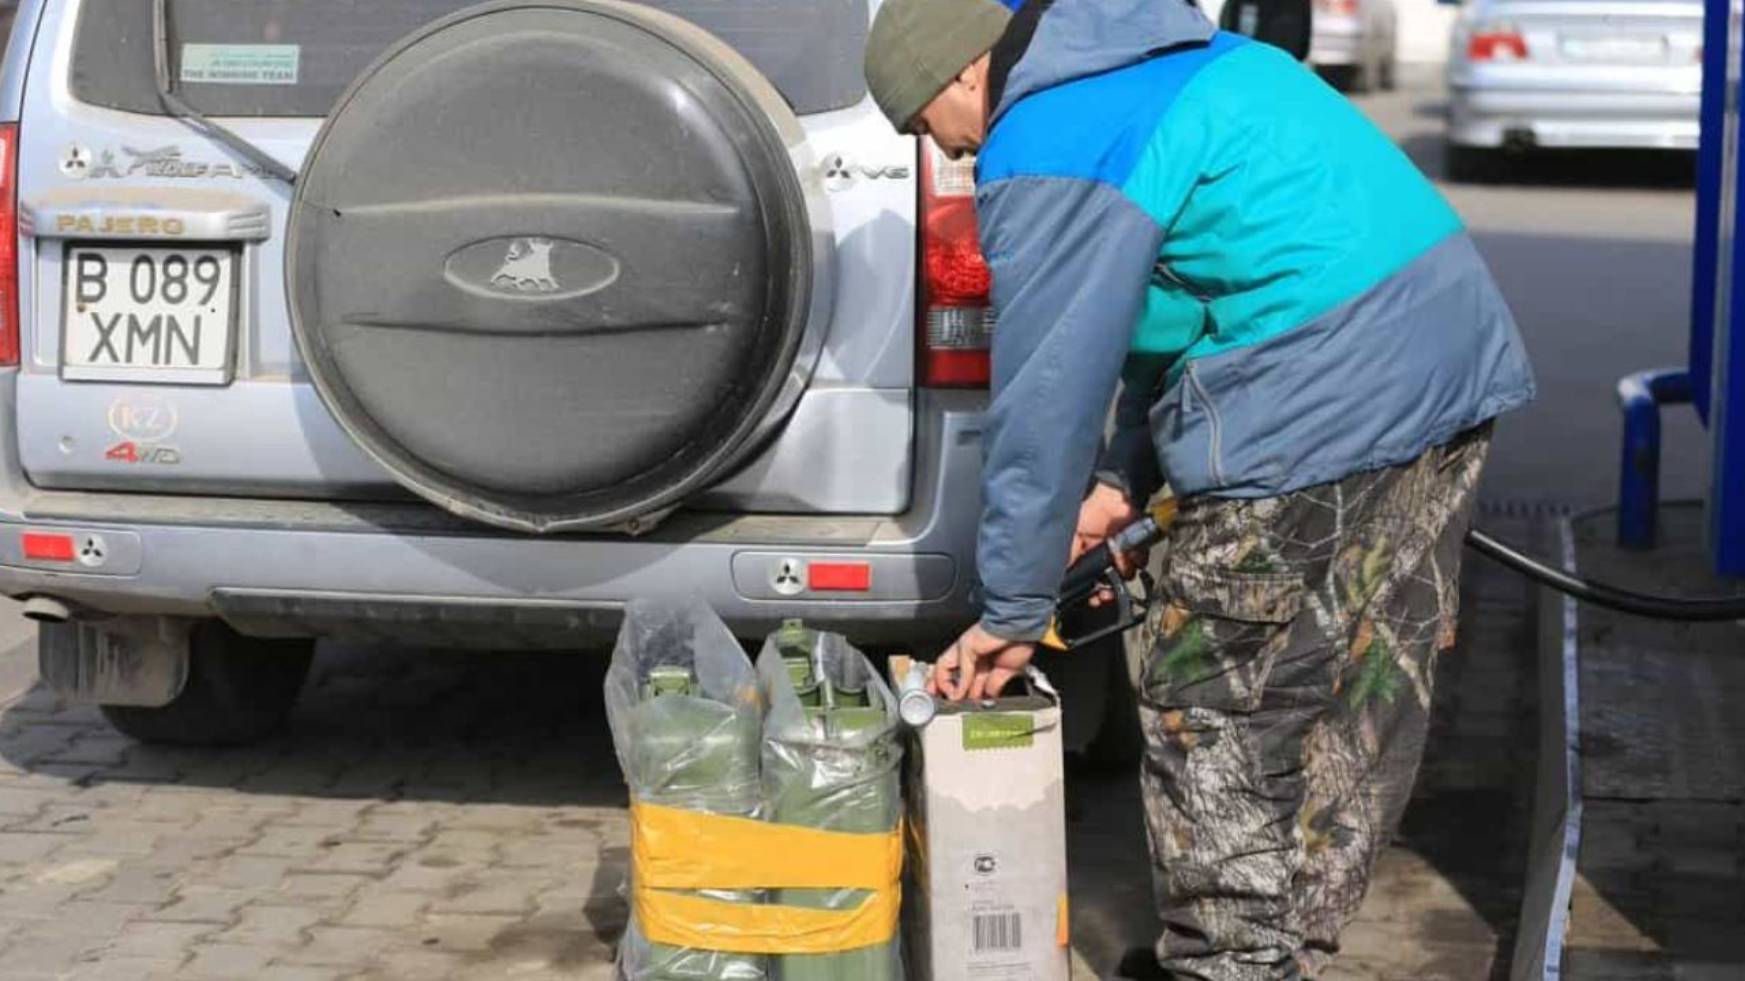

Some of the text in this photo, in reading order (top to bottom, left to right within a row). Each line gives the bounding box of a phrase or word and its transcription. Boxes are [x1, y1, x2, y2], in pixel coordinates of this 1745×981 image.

[56, 214, 186, 236] PAJERO
[76, 252, 222, 306] B 089
[88, 311, 202, 366] XMN
